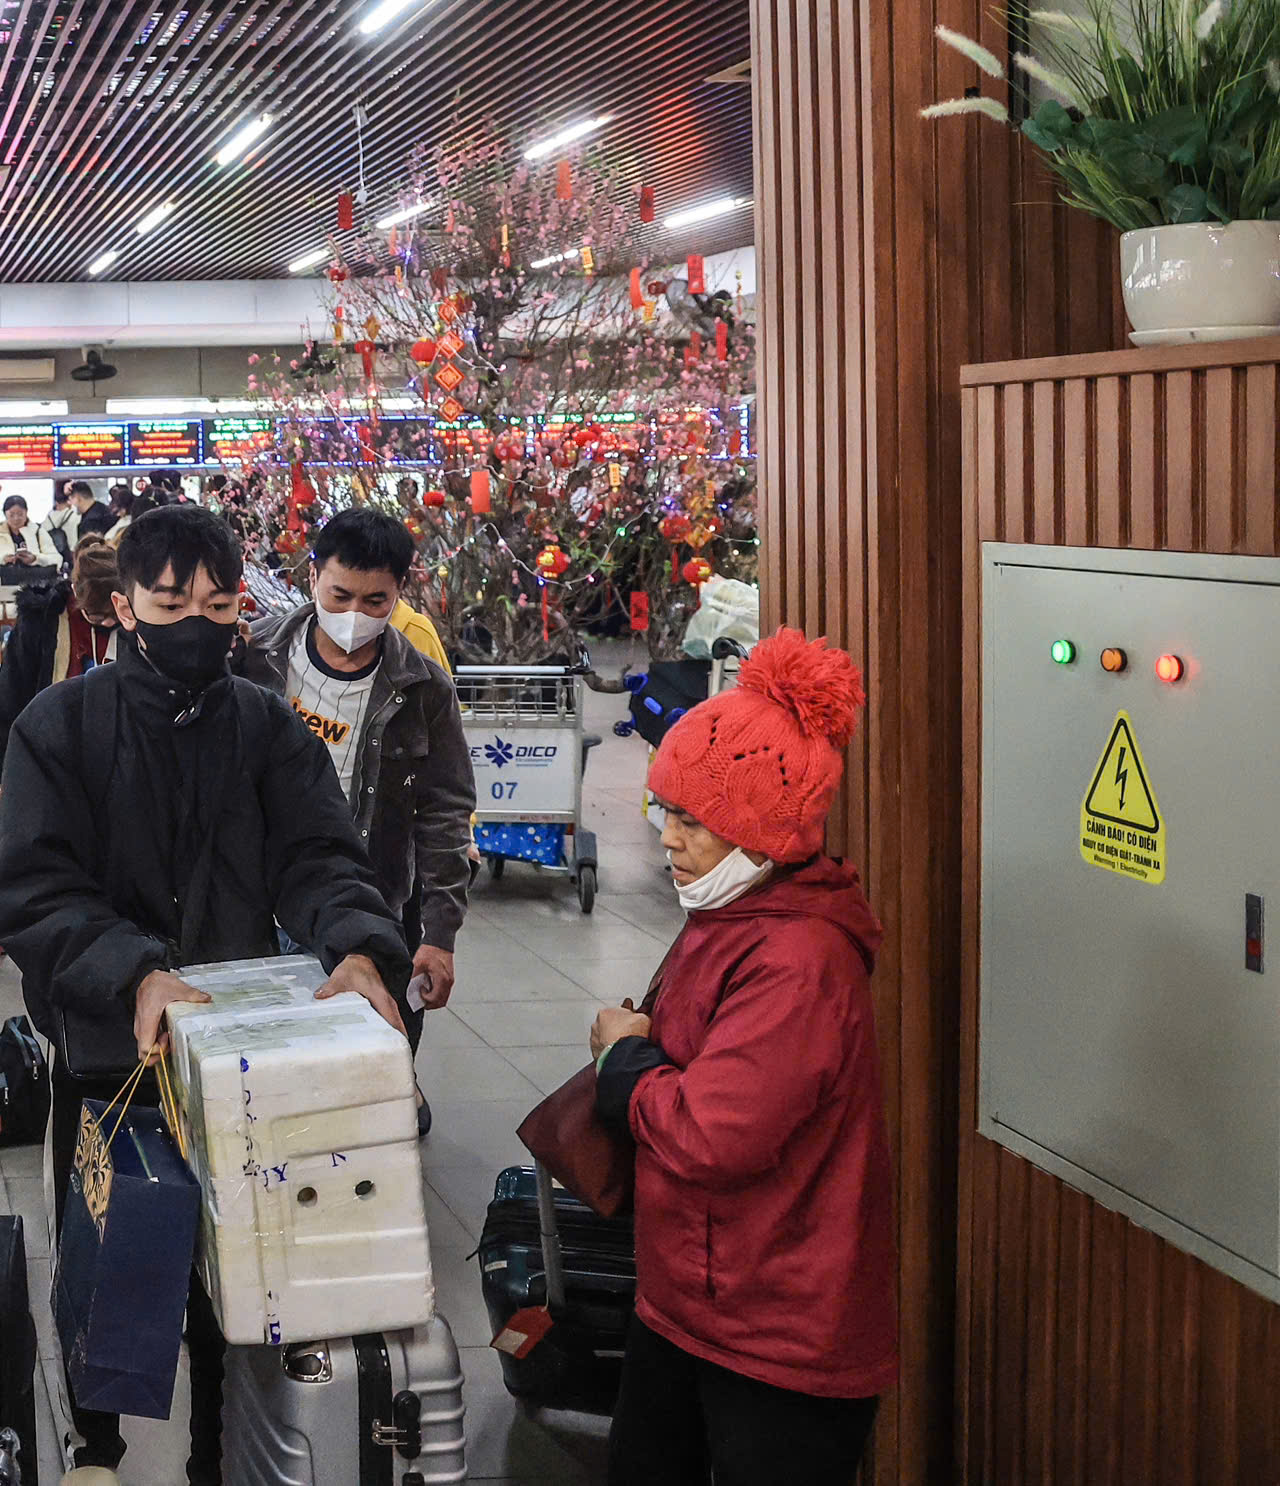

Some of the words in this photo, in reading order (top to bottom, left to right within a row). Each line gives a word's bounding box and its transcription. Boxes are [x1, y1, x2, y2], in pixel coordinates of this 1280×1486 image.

[515, 746, 557, 758] DICO
[491, 781, 518, 800] 07
[1086, 817, 1106, 837] CẢNH
[1127, 831, 1137, 846] CÓ
